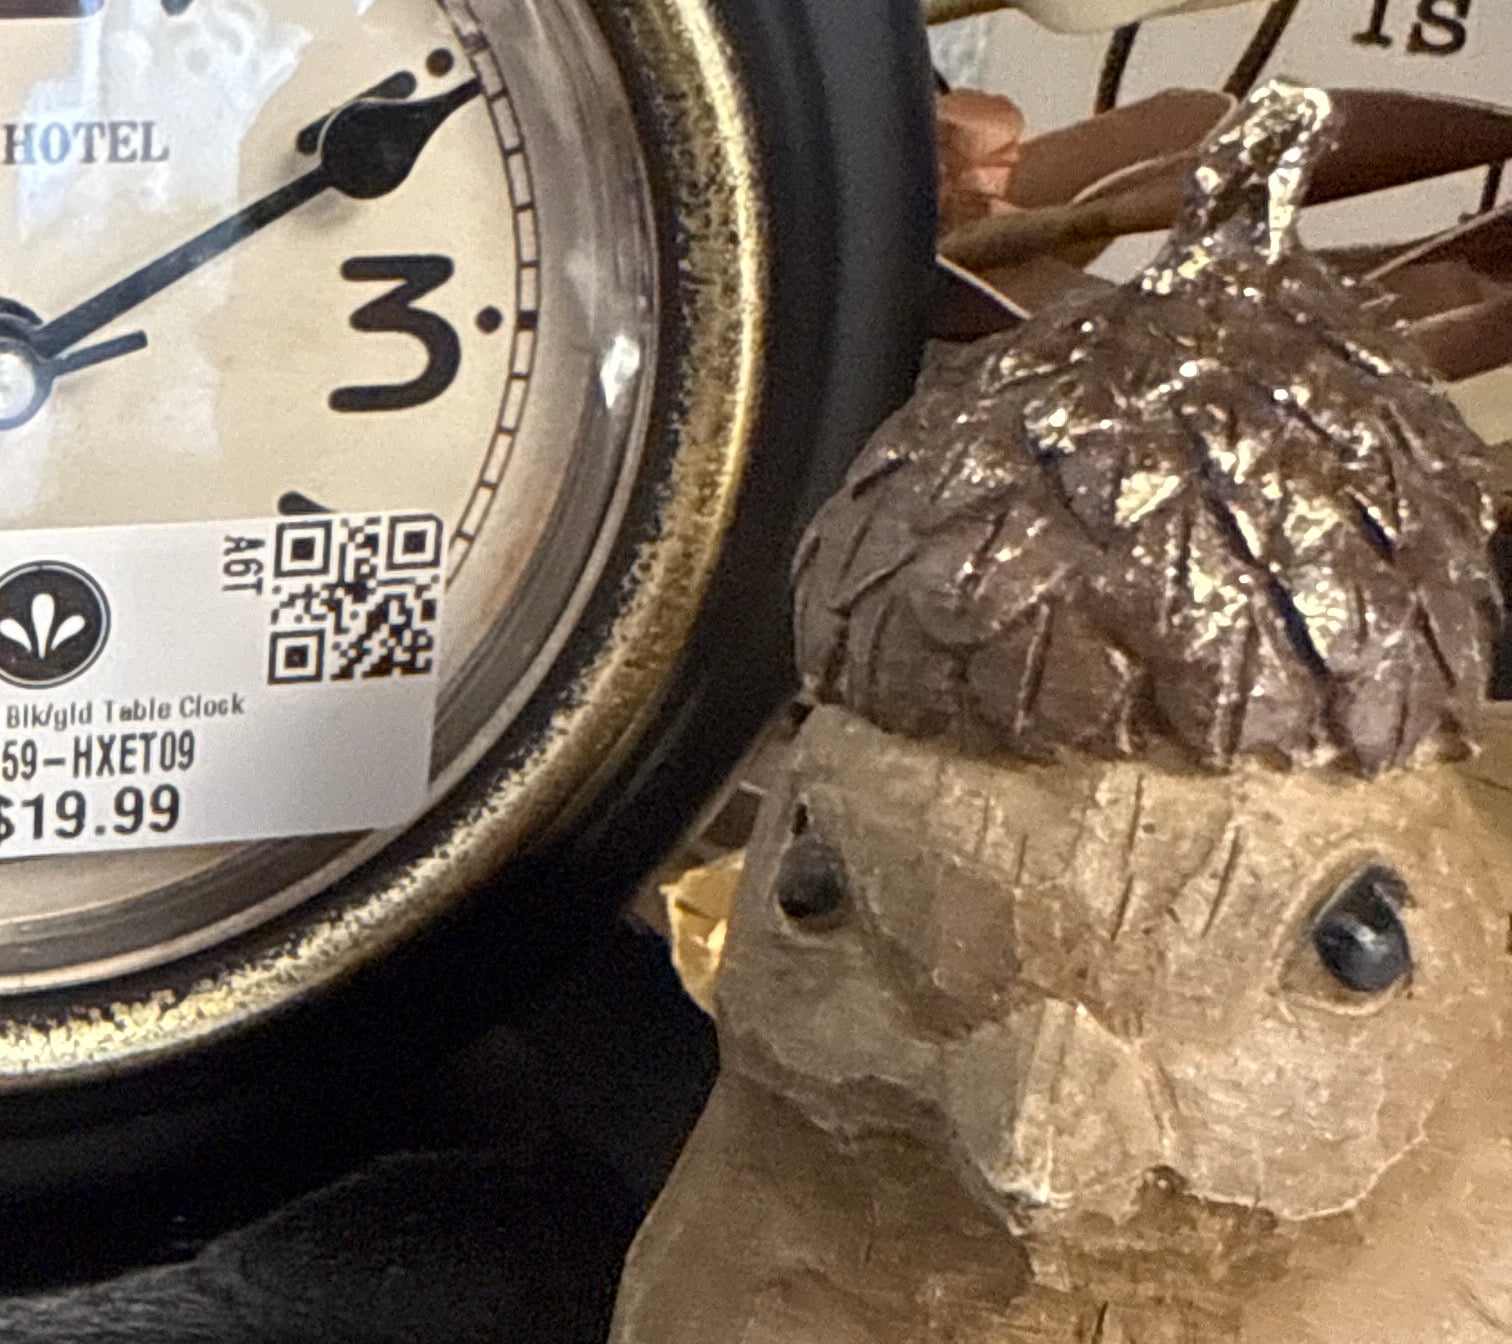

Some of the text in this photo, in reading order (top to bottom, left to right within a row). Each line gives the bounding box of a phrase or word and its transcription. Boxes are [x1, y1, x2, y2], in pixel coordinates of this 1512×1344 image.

[2, 120, 171, 166] HOTEL
[327, 254, 462, 414] 3
[221, 534, 266, 596] A6T
[6, 701, 93, 732] Blk/gld
[104, 697, 172, 723] Table
[179, 692, 246, 719] Clock
